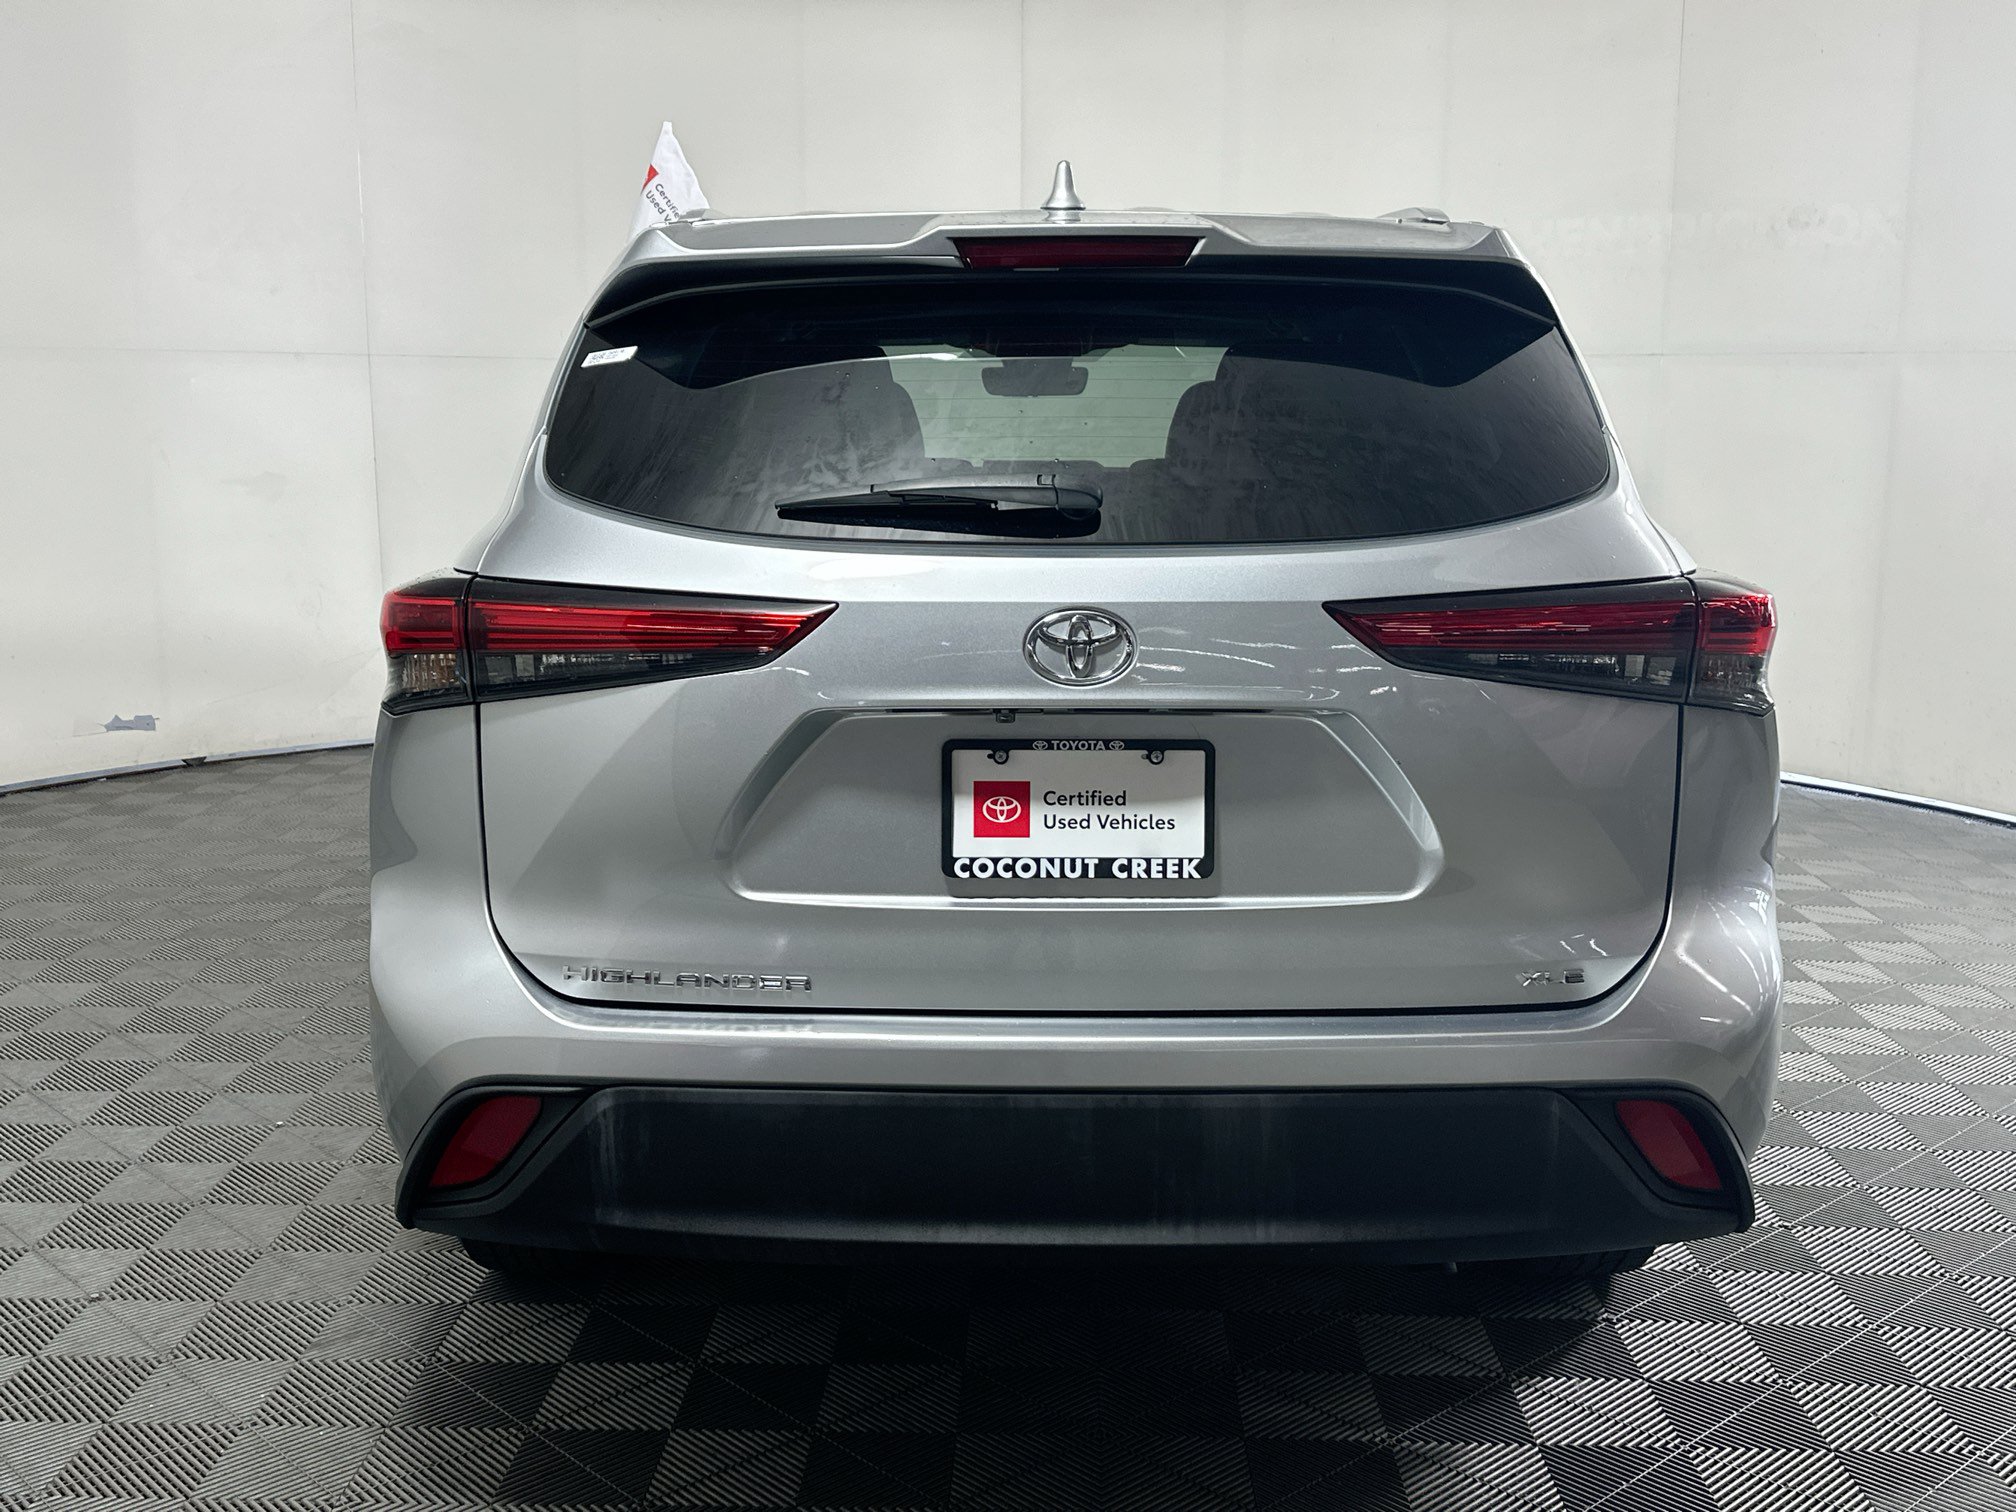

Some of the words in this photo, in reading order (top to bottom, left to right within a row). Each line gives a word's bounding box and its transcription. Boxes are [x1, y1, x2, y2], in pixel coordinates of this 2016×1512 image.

[645, 190, 666, 215] Used
[655, 183, 680, 218] Certifie
[1051, 740, 1106, 751] TOYOTA
[1043, 790, 1127, 806] Certified
[1043, 814, 1091, 830] Used
[1097, 814, 1175, 830] Vehicles
[953, 857, 1099, 879] COCONUT
[1111, 857, 1202, 879] CREEK
[562, 964, 813, 992] HIGHLANDER
[1521, 968, 1585, 986] XLE
